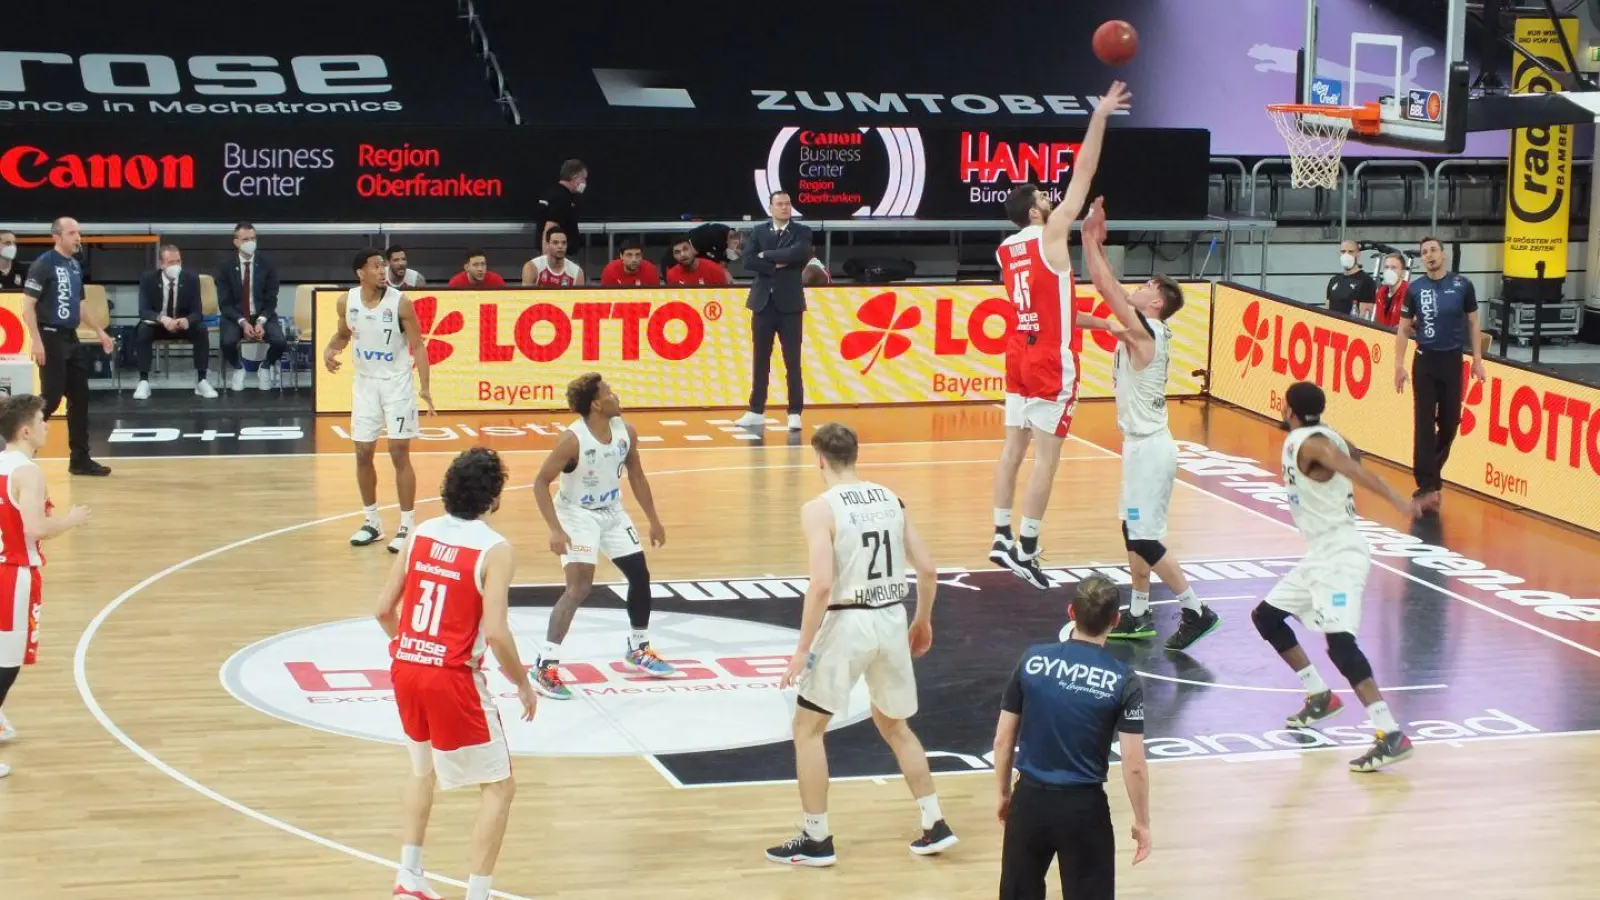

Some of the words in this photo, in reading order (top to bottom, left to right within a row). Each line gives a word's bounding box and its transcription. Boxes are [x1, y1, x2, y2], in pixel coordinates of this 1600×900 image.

[104, 99, 134, 113] in
[151, 99, 403, 114] Mechatronics
[800, 131, 862, 145] Canon
[224, 143, 334, 169] Business
[358, 144, 440, 169] Region
[800, 147, 861, 162] Business
[1556, 124, 1568, 186] BAMBE
[0, 145, 195, 190] Canon
[800, 162, 844, 177] Center
[222, 171, 305, 197] Center
[357, 173, 502, 198] Oberfranken
[800, 180, 834, 191] Region
[799, 192, 861, 205] Oberfranken
[56, 265, 70, 319] GYMPER
[1014, 270, 1031, 311] 45
[1420, 288, 1436, 338] GYMPER
[384, 329, 392, 345] 7
[364, 351, 394, 363] VTG
[478, 381, 554, 406] Bayern
[933, 373, 1003, 396] Bayern
[108, 426, 304, 442] D+S
[396, 417, 405, 433] 7
[1485, 462, 1528, 497] Bayern
[600, 488, 620, 502] VT
[840, 488, 889, 506] HOLLATZ
[862, 529, 893, 581] 21
[855, 583, 905, 605] HAMBURG
[411, 580, 447, 637] 31
[401, 633, 447, 657] brose
[1025, 655, 1118, 691] GYMPER
